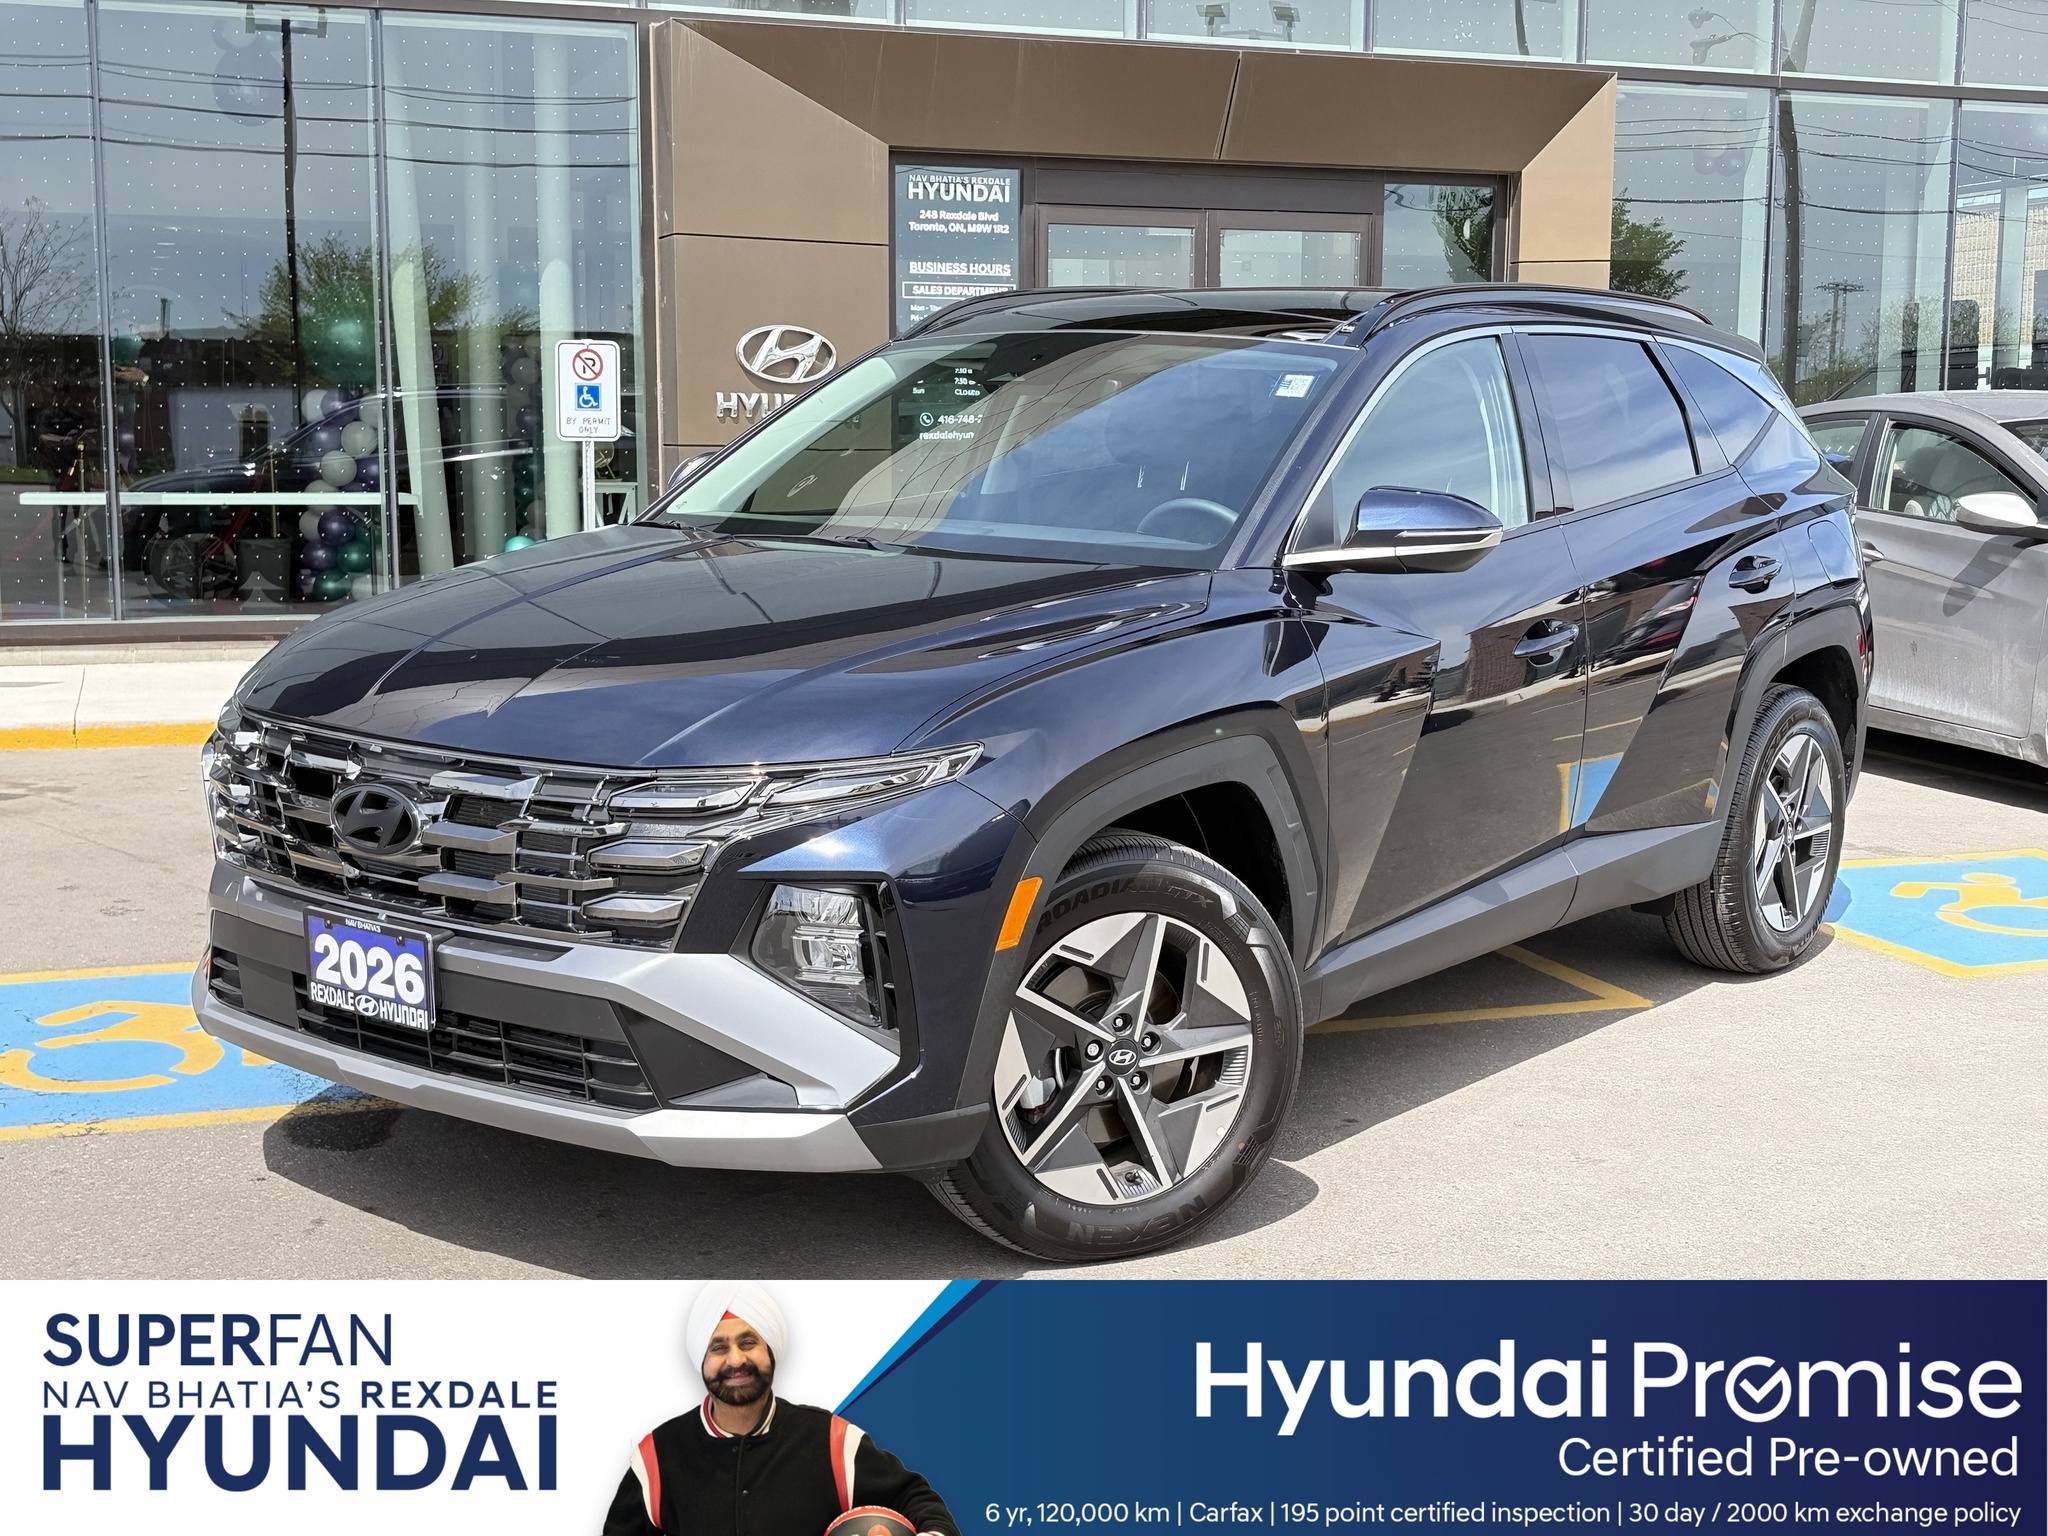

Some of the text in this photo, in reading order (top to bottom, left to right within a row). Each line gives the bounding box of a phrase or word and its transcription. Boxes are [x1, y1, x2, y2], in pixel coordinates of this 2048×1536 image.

[930, 175, 969, 184] BHATIA'S
[971, 177, 1011, 186] REXDALE
[908, 182, 1010, 203] HYUNDAI
[919, 210, 999, 222] 248 Rexdale Blvd
[909, 222, 1010, 234] Toronto, ON, M9W 1R2
[909, 262, 1011, 275] BUSINESS HOURS
[912, 285, 943, 295] SALES
[567, 417, 611, 425] BY PERMIT
[579, 426, 599, 434] ONLY
[314, 933, 425, 1005] 2026
[310, 981, 429, 1031] REXDALE HYUNDAI
